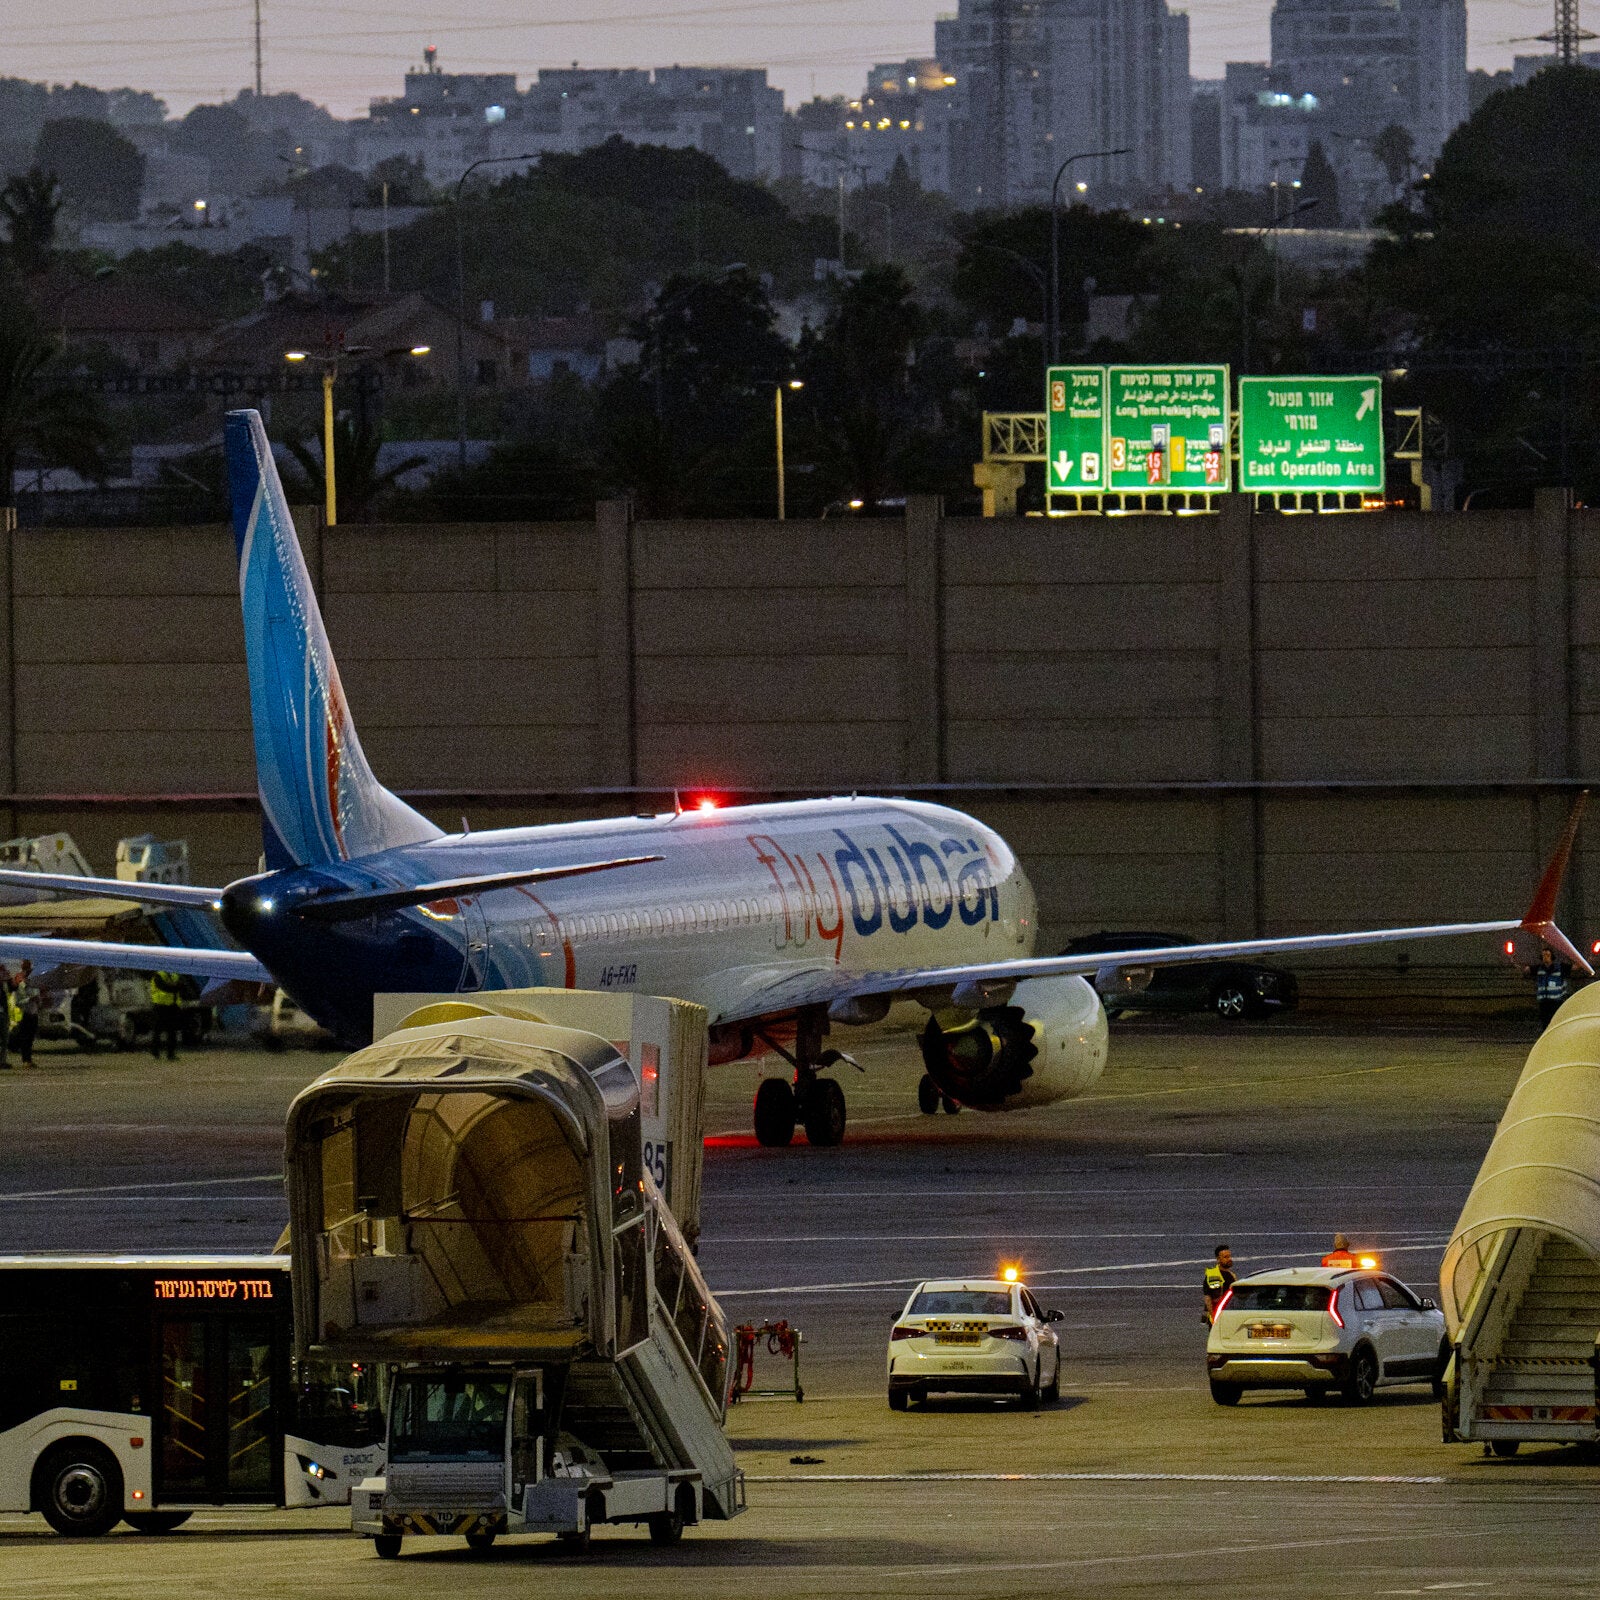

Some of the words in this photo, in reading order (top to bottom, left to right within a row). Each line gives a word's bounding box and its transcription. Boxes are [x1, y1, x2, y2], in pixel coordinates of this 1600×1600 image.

[1054, 386, 1065, 407] 3
[1267, 390, 1303, 407] תפעול
[1308, 392, 1334, 407] אזור
[1069, 407, 1101, 418] Terminal
[1116, 405, 1138, 418] Long
[1138, 404, 1160, 416] Term
[1160, 405, 1191, 419] Parking
[1192, 404, 1220, 419] Flights
[1284, 415, 1318, 430] מזרחי
[1113, 442, 1124, 466] 3
[1147, 452, 1161, 469] 15
[1205, 452, 1220, 468] 22
[1248, 460, 1275, 476] East
[1281, 460, 1341, 480] Operation
[1346, 460, 1375, 476] Area
[746, 803, 1000, 965] flydubai
[599, 964, 637, 987] A6-FKR
[154, 1280, 195, 1298] נעימה
[197, 1279, 238, 1298] לטיסה
[239, 1280, 273, 1300] בדרך
